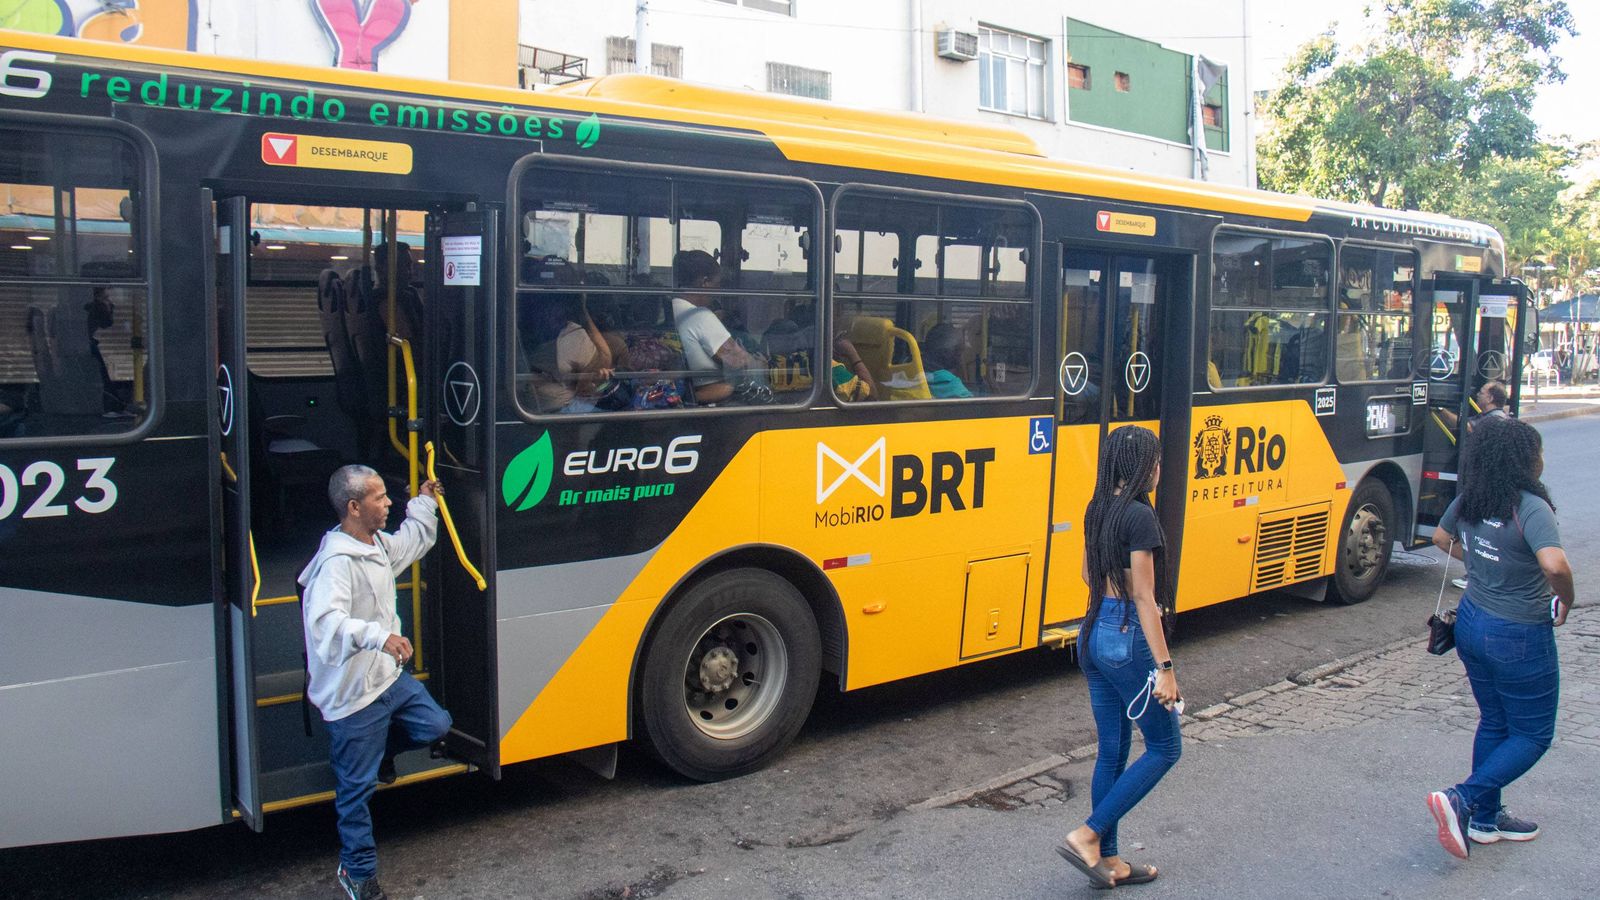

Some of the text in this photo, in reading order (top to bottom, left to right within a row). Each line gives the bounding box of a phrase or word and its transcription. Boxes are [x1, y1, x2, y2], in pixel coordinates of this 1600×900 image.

[80, 72, 346, 123] reduzindo
[369, 100, 564, 139] emissões
[311, 146, 389, 162] DESEMBARQUE
[1351, 216, 1367, 228] AR
[1317, 396, 1334, 409] 2025
[563, 434, 703, 476] EURO6
[1234, 425, 1286, 476] Rio
[558, 482, 676, 506] Ar mais puro
[890, 447, 996, 519] BRT
[1192, 477, 1283, 502] PREFEITURA
[814, 503, 885, 529] MobiRIO
